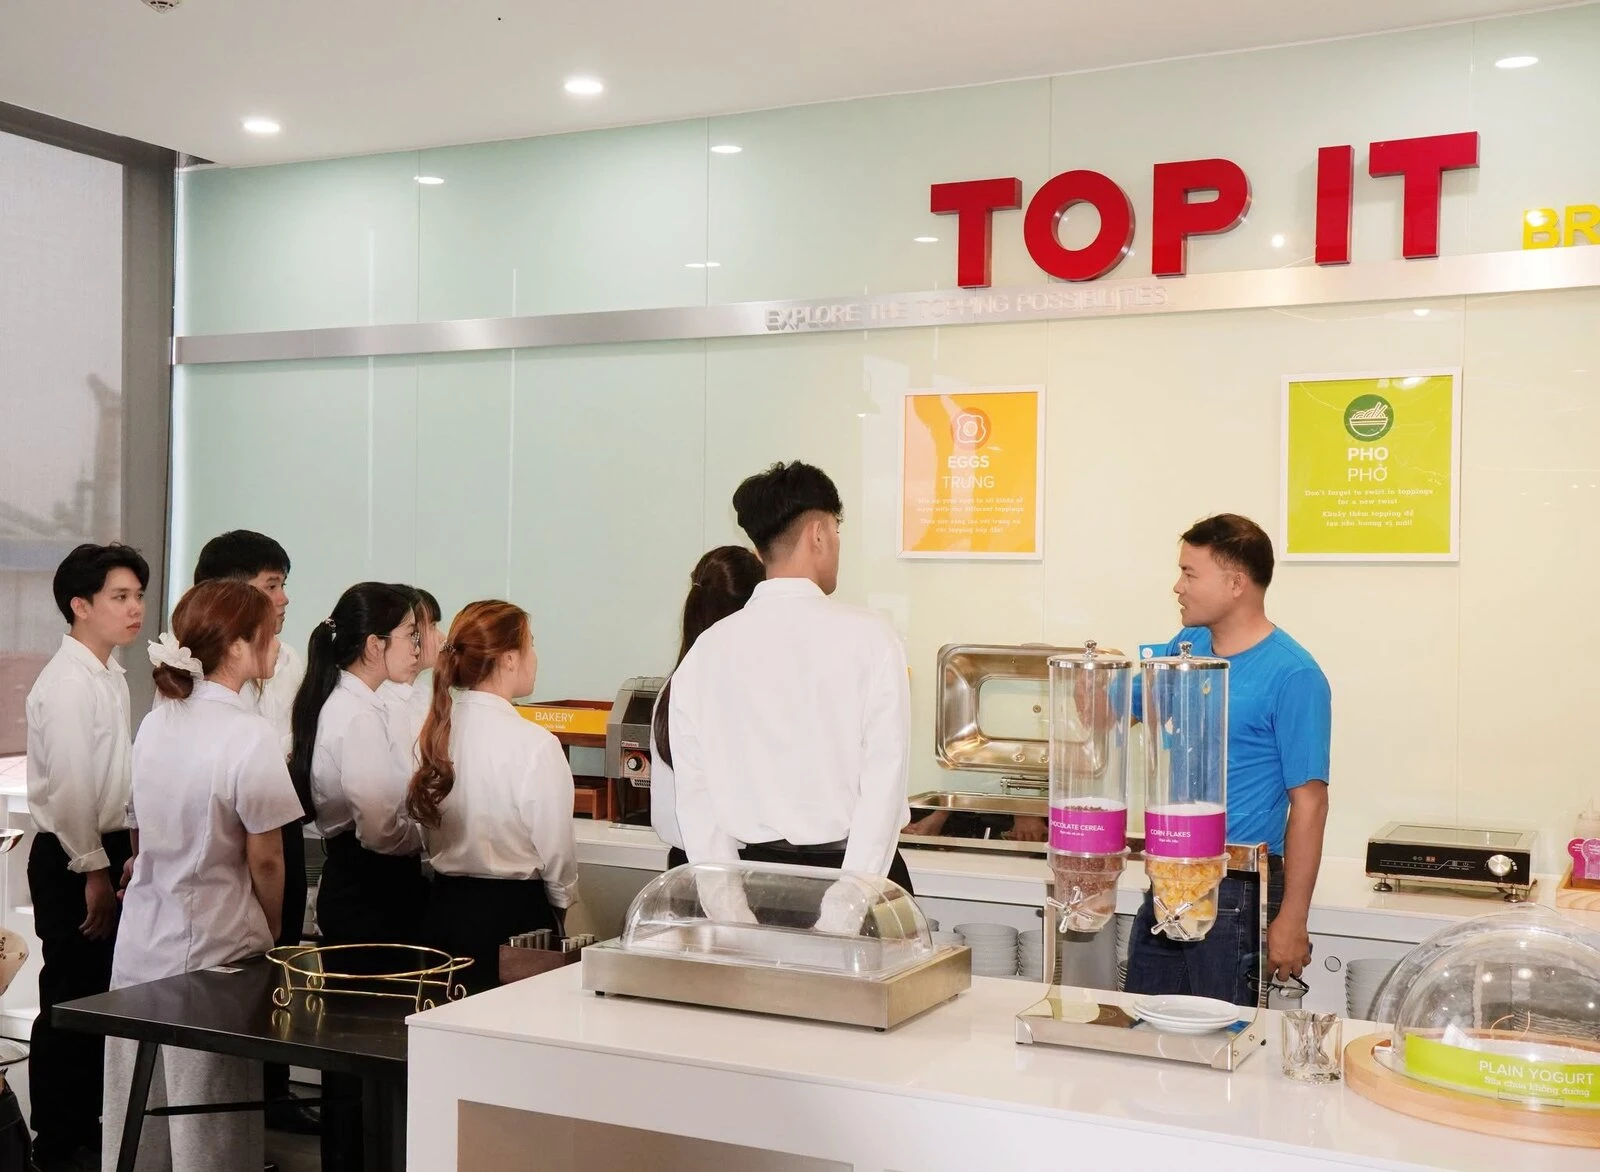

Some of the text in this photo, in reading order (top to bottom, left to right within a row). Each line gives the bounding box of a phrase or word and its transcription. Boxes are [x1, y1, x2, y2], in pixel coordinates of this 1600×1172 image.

[930, 131, 1480, 290] TOP IT
[764, 303, 861, 332] EXPLORE
[869, 300, 909, 321] THE
[1347, 447, 1389, 461] PHO
[947, 456, 990, 469] EGGS
[1347, 464, 1388, 482] PHỞ
[1398, 487, 1433, 496] toppings
[535, 711, 575, 723] BAKERY
[1080, 824, 1105, 832] CEREAL
[1166, 830, 1191, 838] FLAKES
[1480, 1060, 1594, 1085] PLAIN YOGURT
